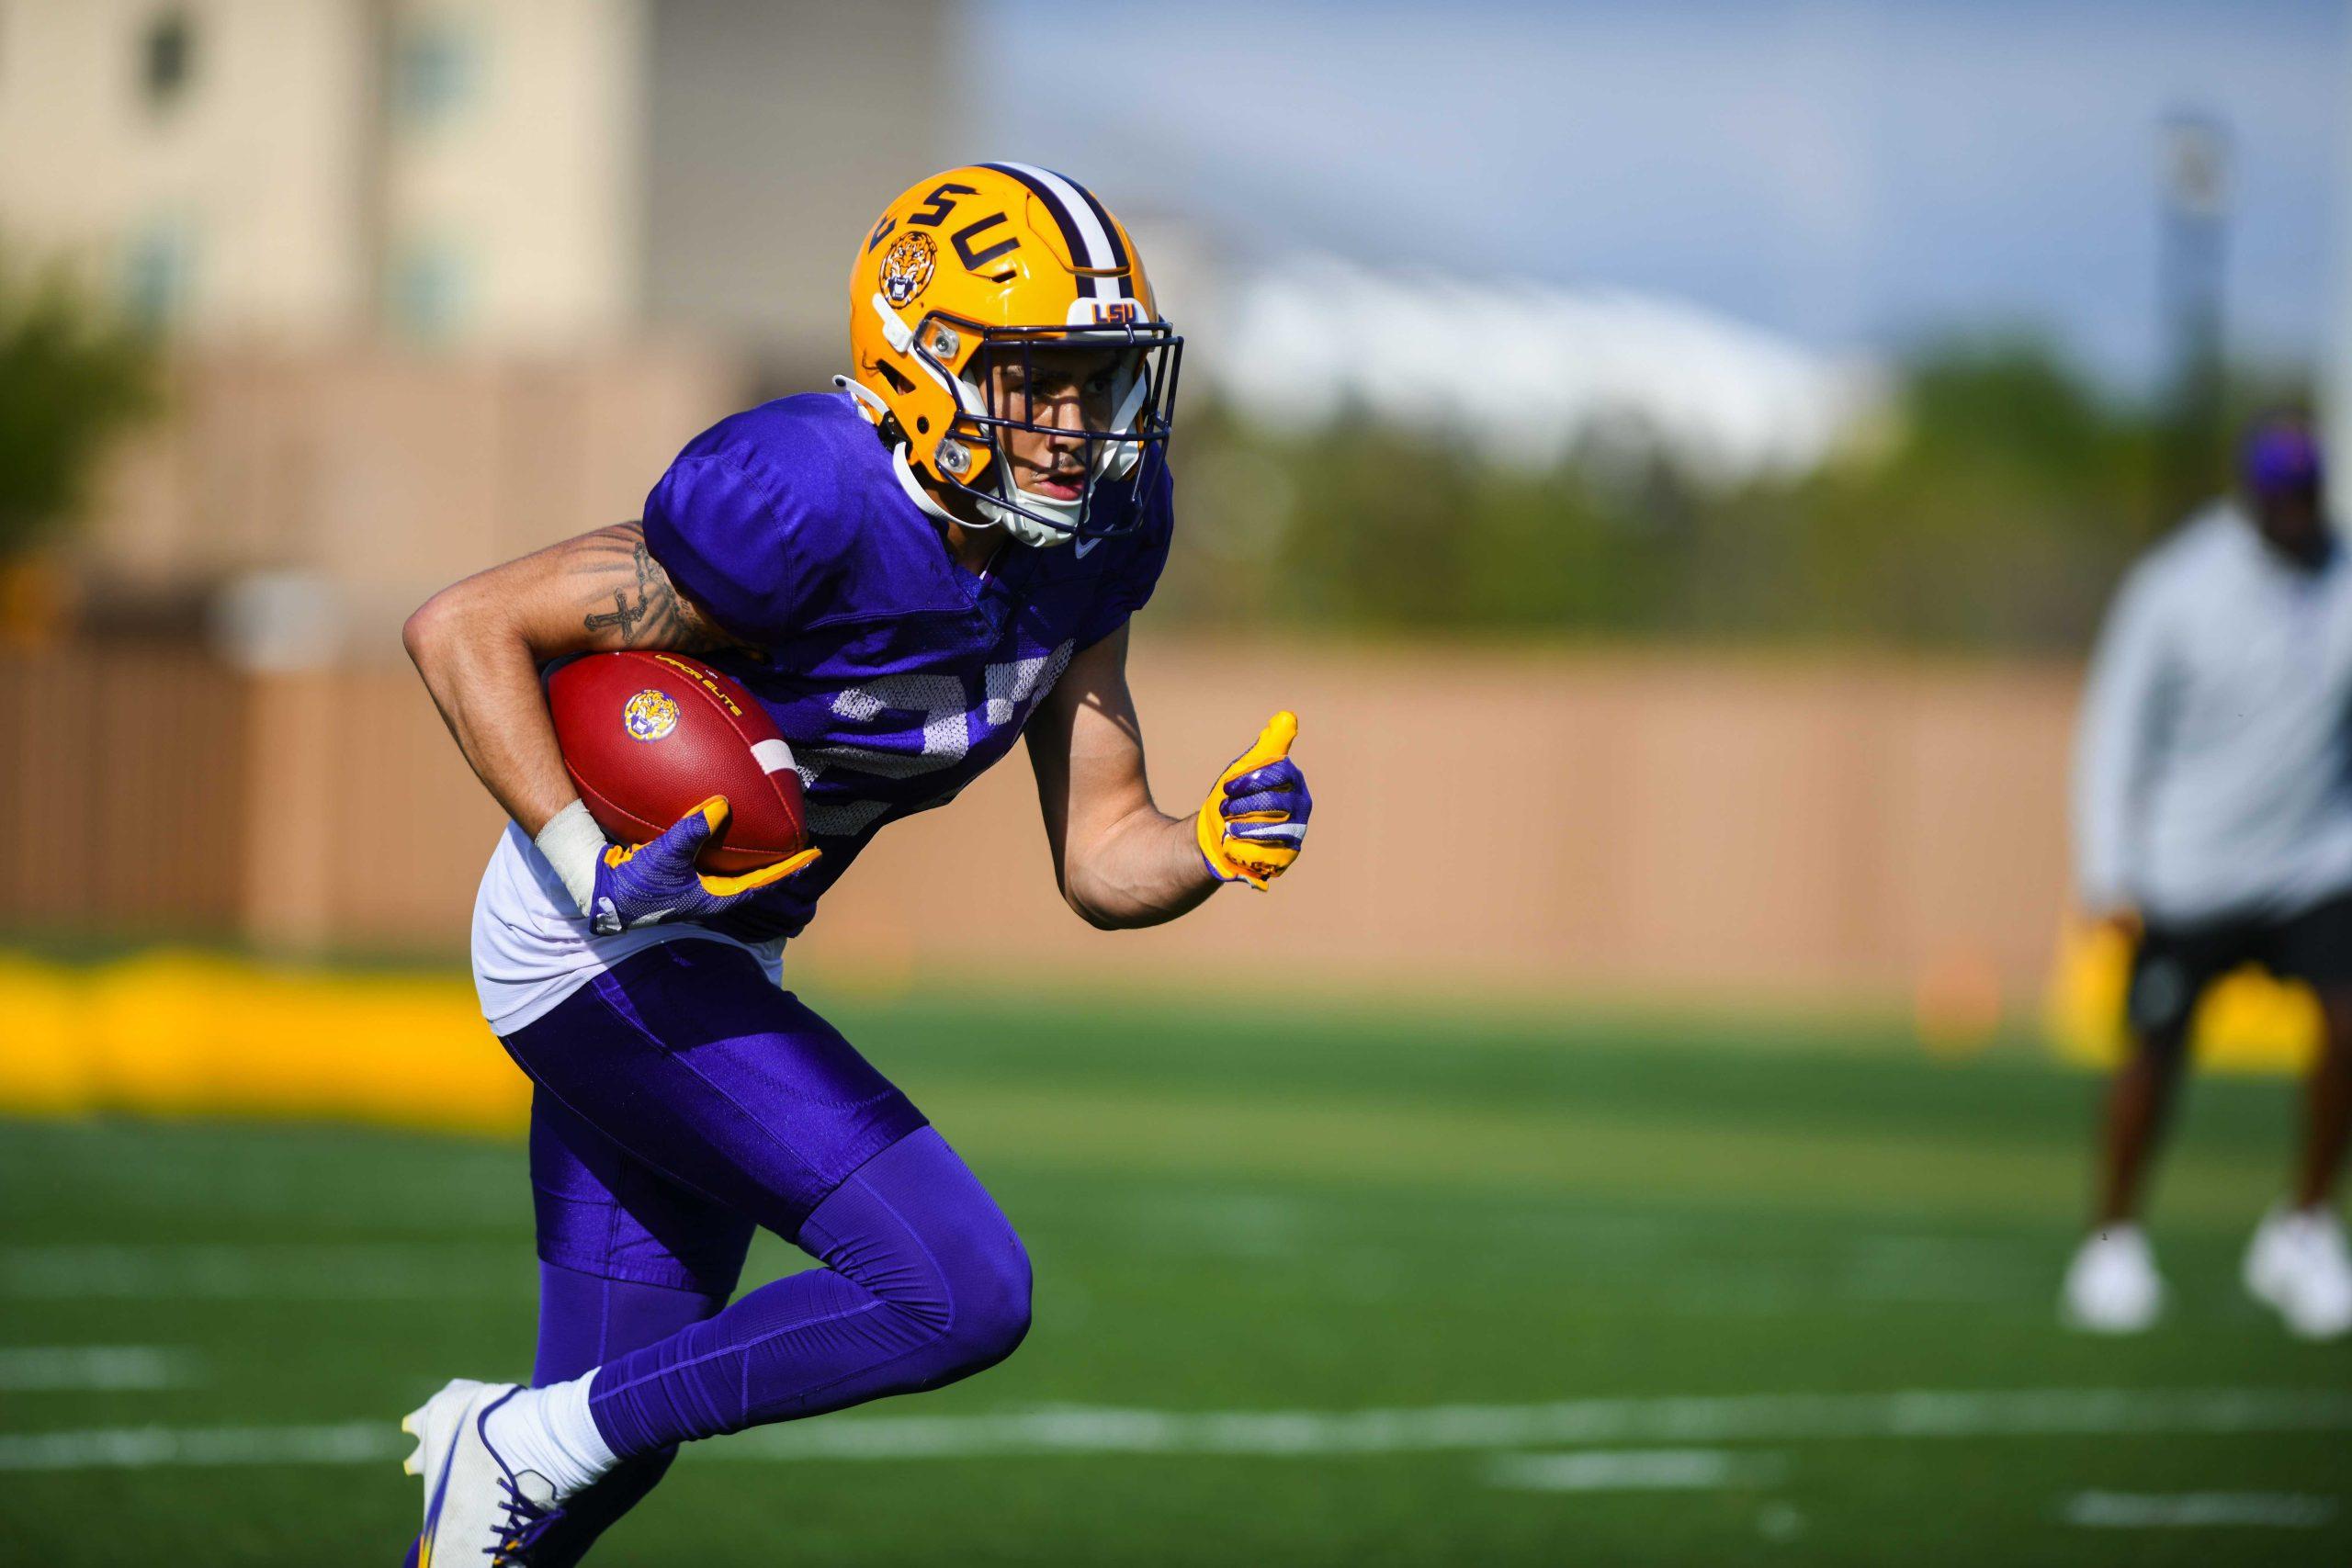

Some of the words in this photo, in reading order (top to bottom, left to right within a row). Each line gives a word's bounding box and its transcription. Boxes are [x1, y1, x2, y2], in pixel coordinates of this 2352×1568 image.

[868, 183, 1022, 271] LSU
[1091, 304, 1136, 323] LSU
[655, 654, 703, 680] VAPOR
[702, 680, 742, 716] ELITE
